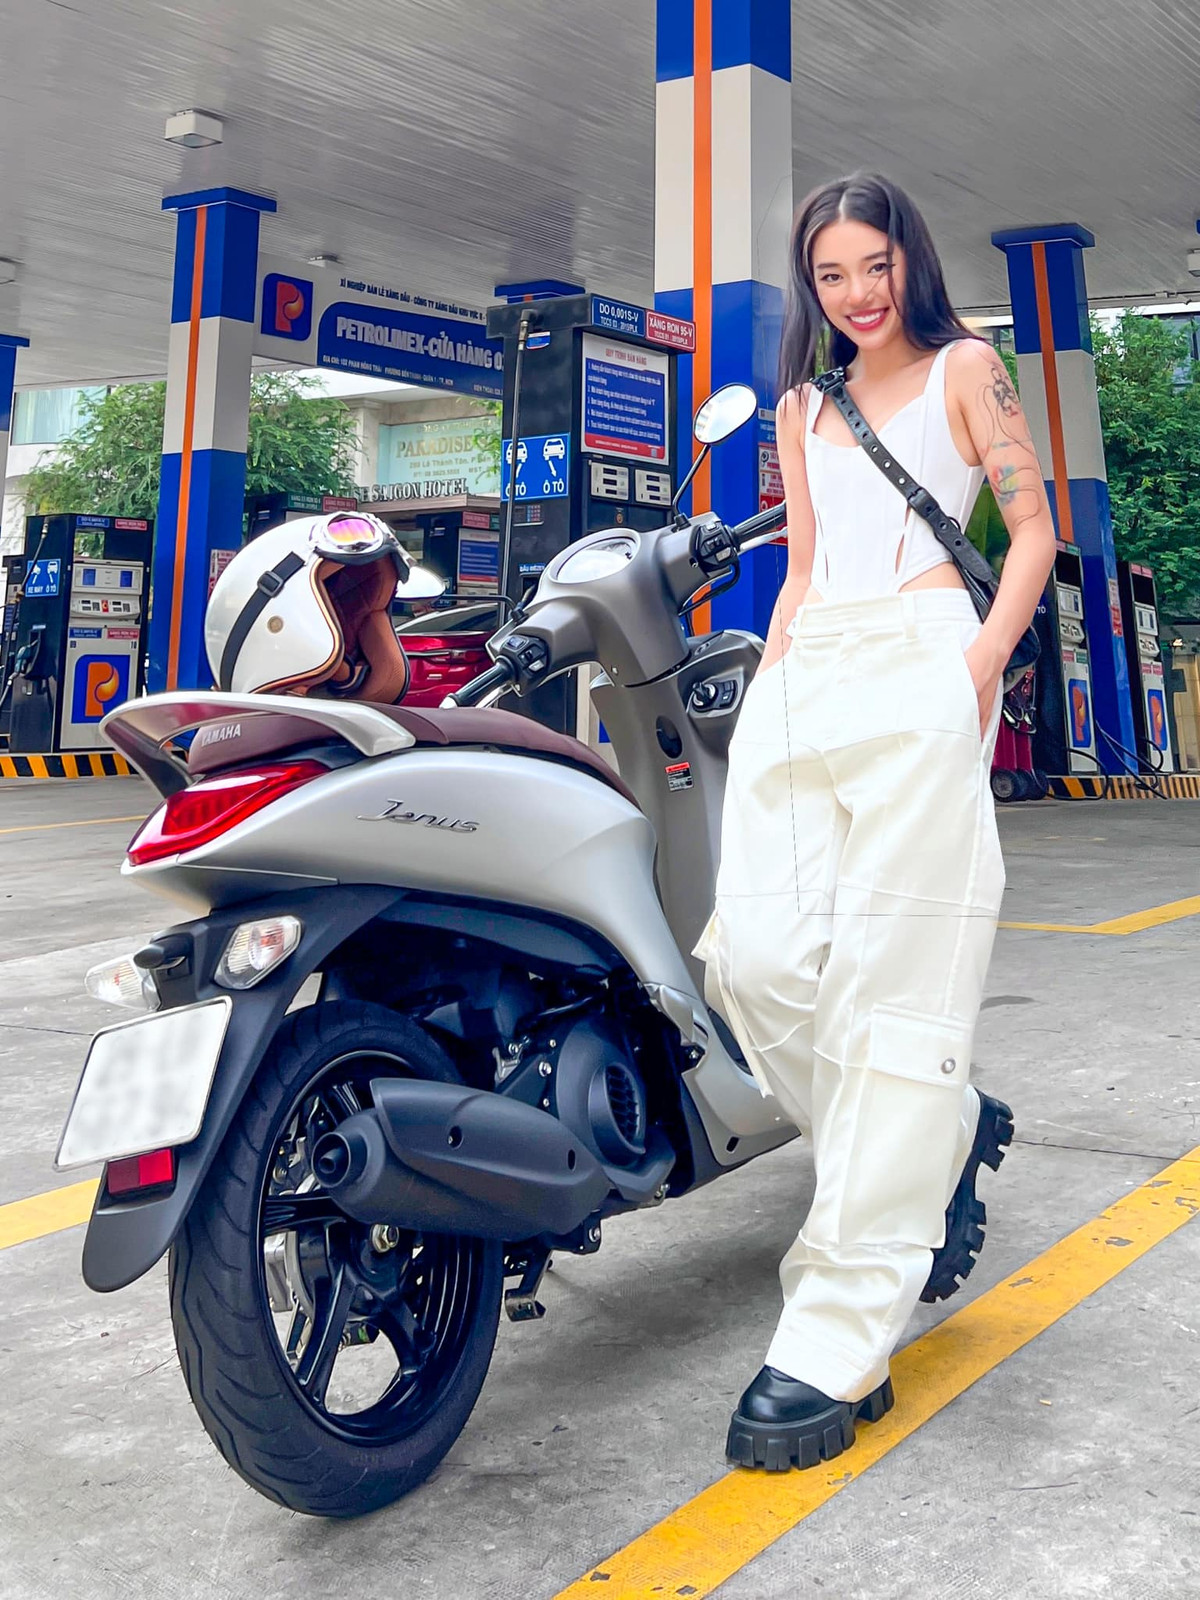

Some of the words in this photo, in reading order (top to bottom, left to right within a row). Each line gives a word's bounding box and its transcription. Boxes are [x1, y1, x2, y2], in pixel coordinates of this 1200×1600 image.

[600, 303, 609, 314] DO
[611, 306, 638, 322] 0,001S-V
[650, 316, 666, 330] XĂNG
[666, 322, 680, 335] RON
[680, 326, 692, 338] 95-V
[456, 341, 492, 368] HÀNG
[371, 482, 421, 501] SAIGON
[424, 478, 467, 497] HOTEL
[543, 479, 550, 494] Ô
[552, 478, 564, 493] TÔ
[201, 723, 241, 747] YAMAHA
